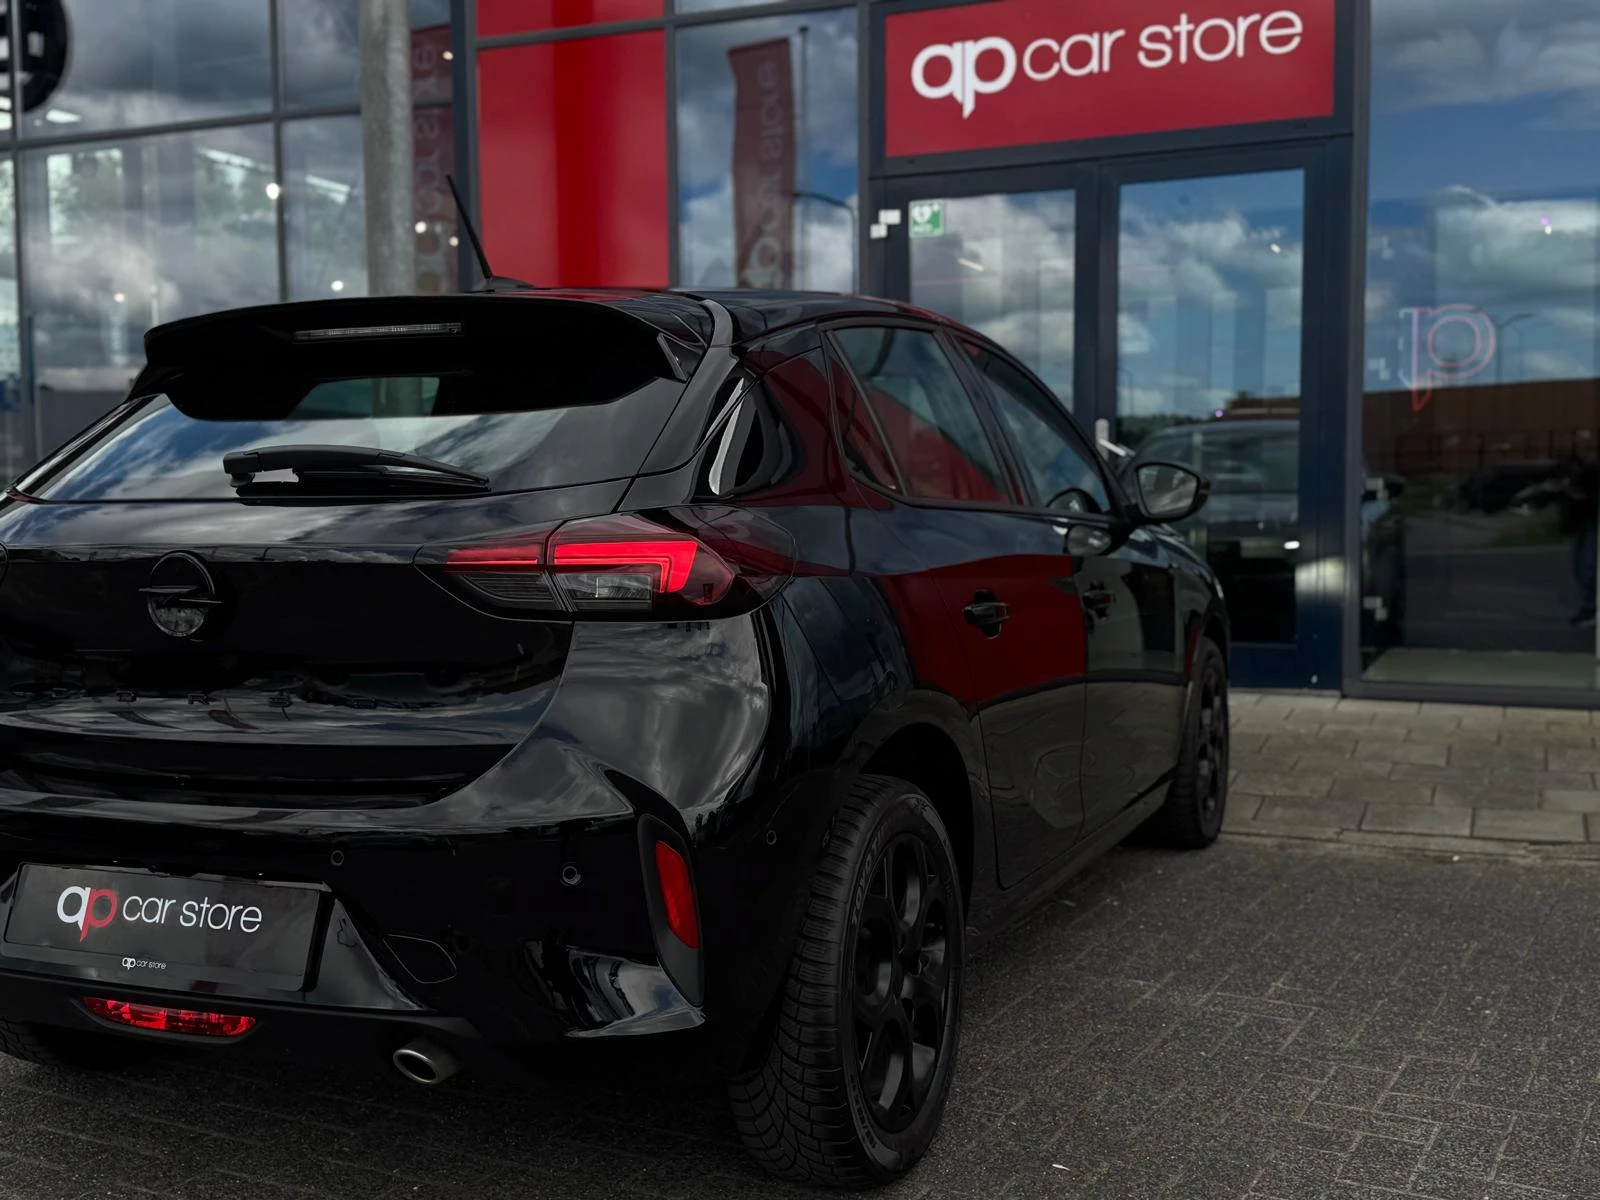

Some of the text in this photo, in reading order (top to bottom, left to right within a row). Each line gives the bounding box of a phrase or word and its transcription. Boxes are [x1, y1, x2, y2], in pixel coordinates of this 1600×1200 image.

[911, 10, 1303, 119] ap car store
[57, 885, 263, 942] ap car store
[136, 959, 149, 968] car
[149, 960, 167, 970] store
